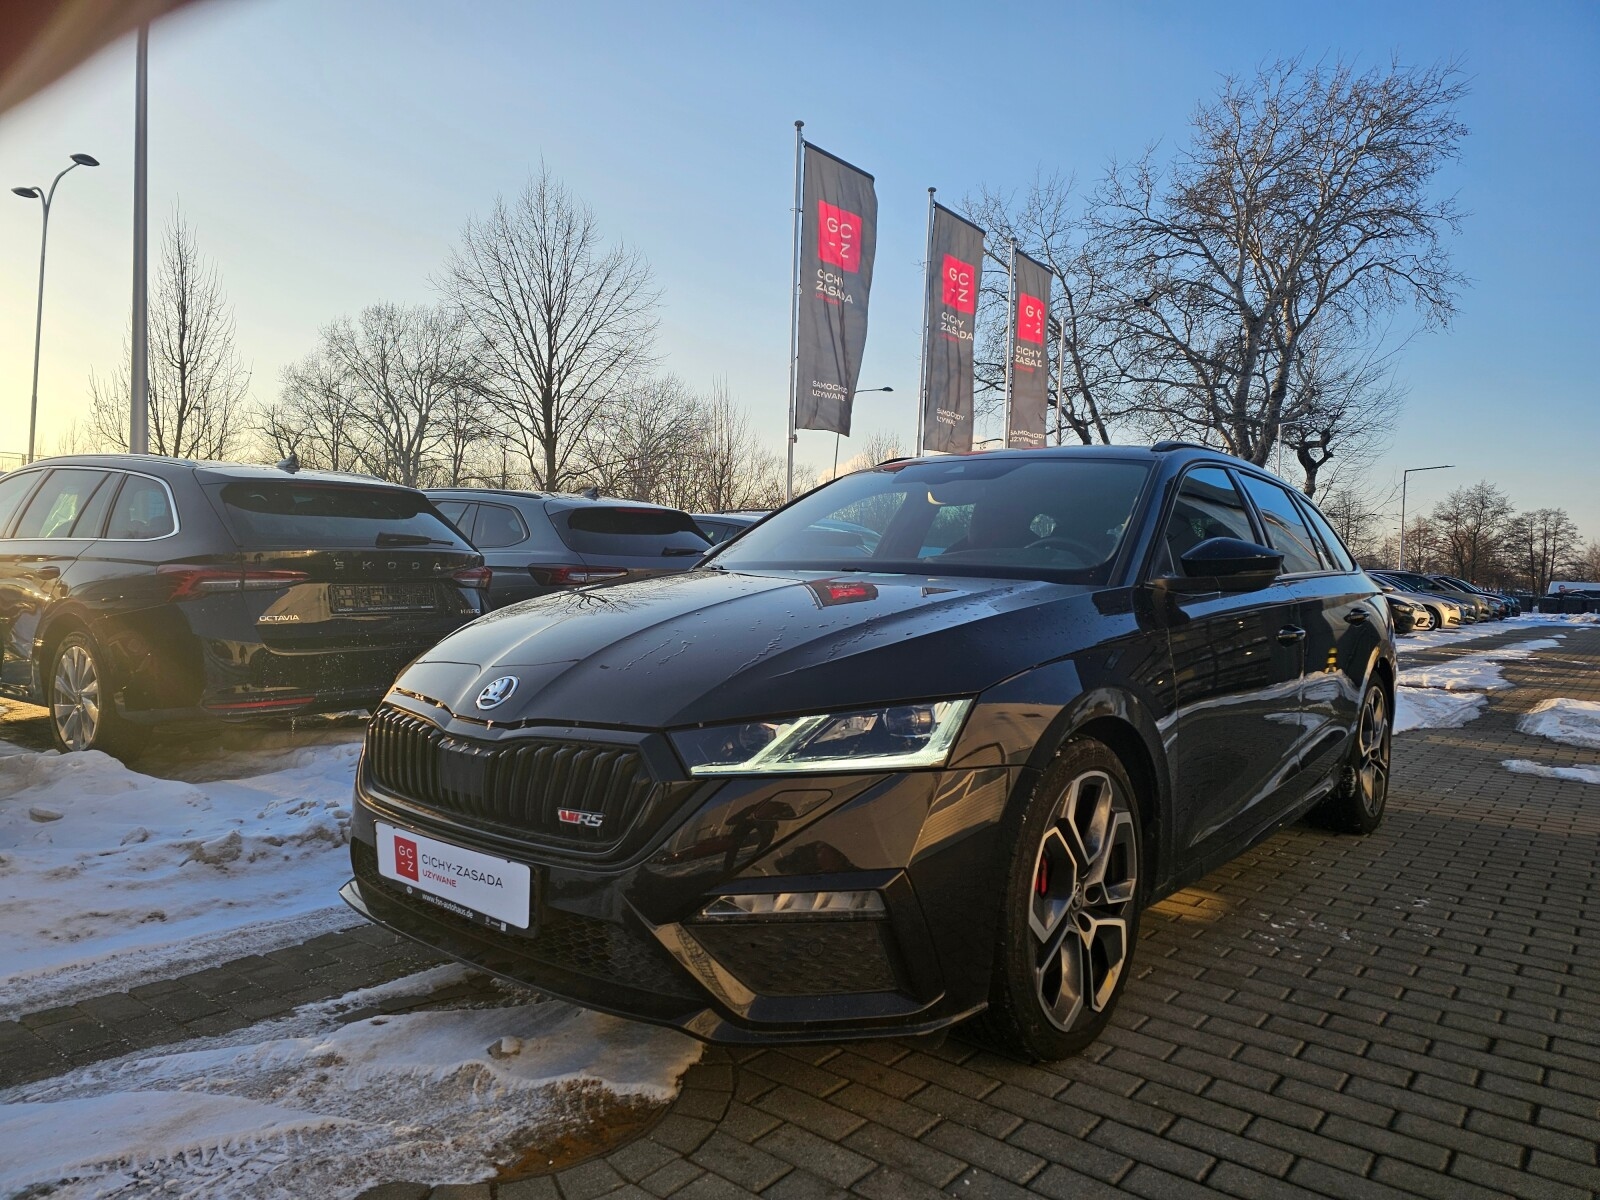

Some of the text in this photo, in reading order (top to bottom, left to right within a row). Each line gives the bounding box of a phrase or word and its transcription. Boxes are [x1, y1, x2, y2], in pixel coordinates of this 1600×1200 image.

[826, 217, 853, 239] GC
[949, 267, 969, 286] GC
[1015, 345, 1042, 359] CICHY
[1015, 354, 1043, 368] ZASAD
[258, 614, 300, 623] OCTAVIA
[398, 845, 413, 859] GC
[421, 854, 504, 889] CICHY-ZASADA
